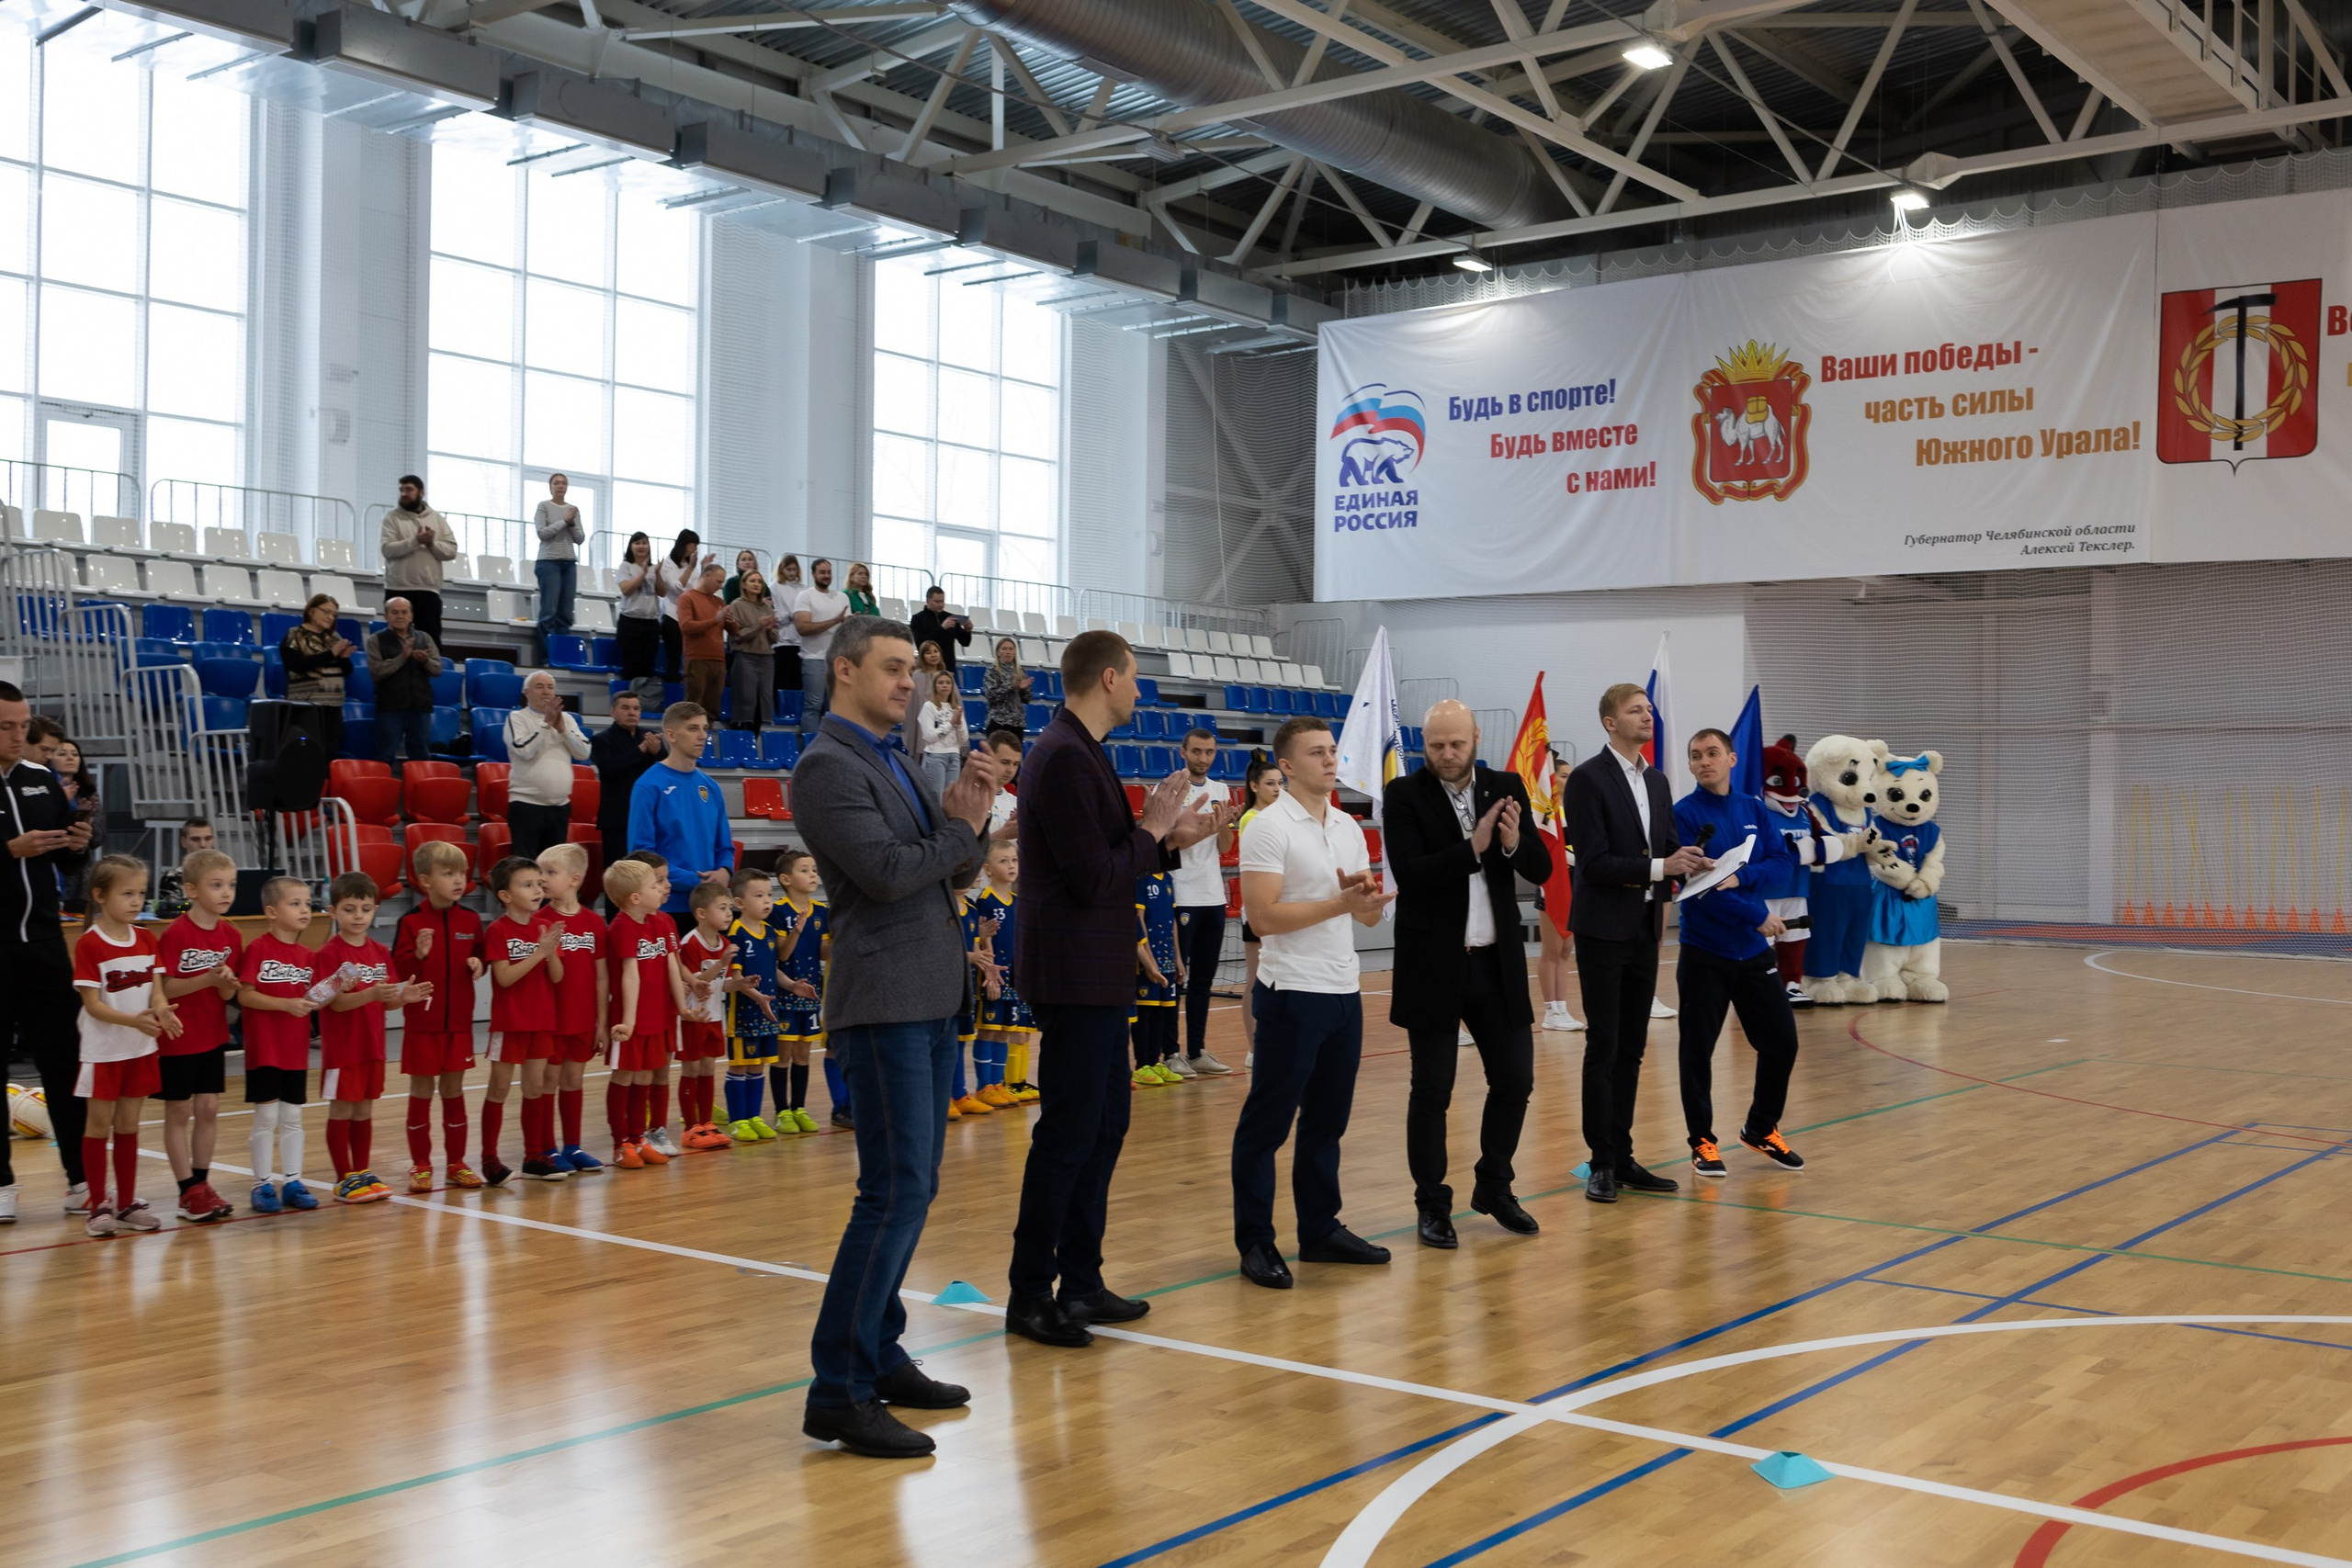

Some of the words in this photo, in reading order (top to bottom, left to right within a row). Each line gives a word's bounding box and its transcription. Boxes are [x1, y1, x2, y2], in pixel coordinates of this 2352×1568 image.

[1821, 355, 1897, 383] Ваши
[1904, 341, 2021, 375] победы
[1449, 396, 1503, 423] Будь
[1509, 393, 1522, 415] в
[1526, 378, 1616, 412] спорте!
[1865, 396, 1945, 423] часть
[1952, 387, 2034, 417] силы
[1490, 433, 1547, 460] Будь
[1552, 423, 1638, 453] вместе
[1916, 434, 2033, 467] Южного
[2040, 421, 2141, 459] Урала!
[1566, 472, 1580, 494] с
[1585, 460, 1657, 492] нами!
[1334, 490, 1419, 513] ЕДИНАЯ
[1334, 510, 1418, 533] РОССИЯ
[1904, 534, 1982, 547] Губернатор
[1985, 525, 2072, 542] Челябинской
[2075, 524, 2136, 536] области
[2020, 540, 2075, 556] Алексей
[2079, 540, 2135, 553] Текслер.
[1147, 884, 1159, 897] 10
[993, 908, 1006, 920] 33
[744, 940, 755, 954] 2
